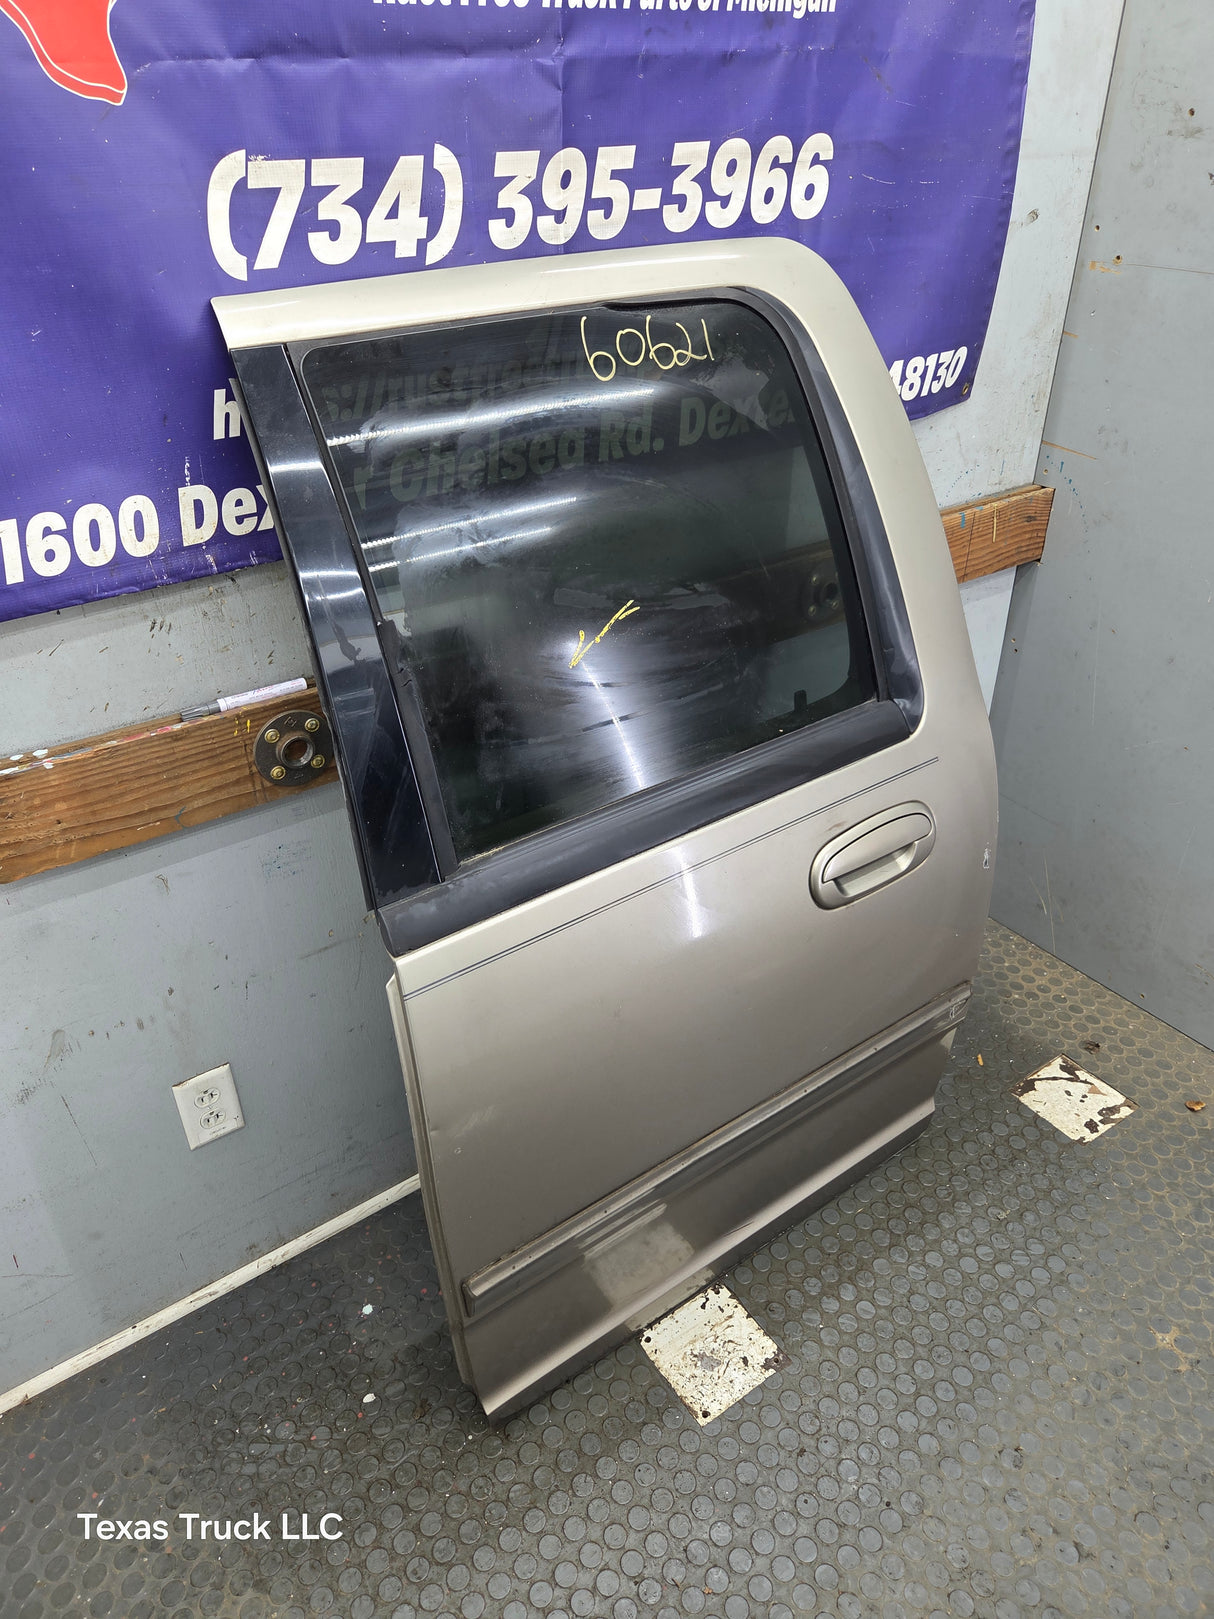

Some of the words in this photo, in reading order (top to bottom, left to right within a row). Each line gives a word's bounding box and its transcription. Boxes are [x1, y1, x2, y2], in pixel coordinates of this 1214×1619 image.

[207, 143, 463, 281] (734)
[488, 132, 834, 250] 395-3966
[580, 314, 715, 382] 60621
[0, 494, 160, 585] 1600
[599, 401, 664, 461] Rd.
[679, 388, 796, 446] Dexe
